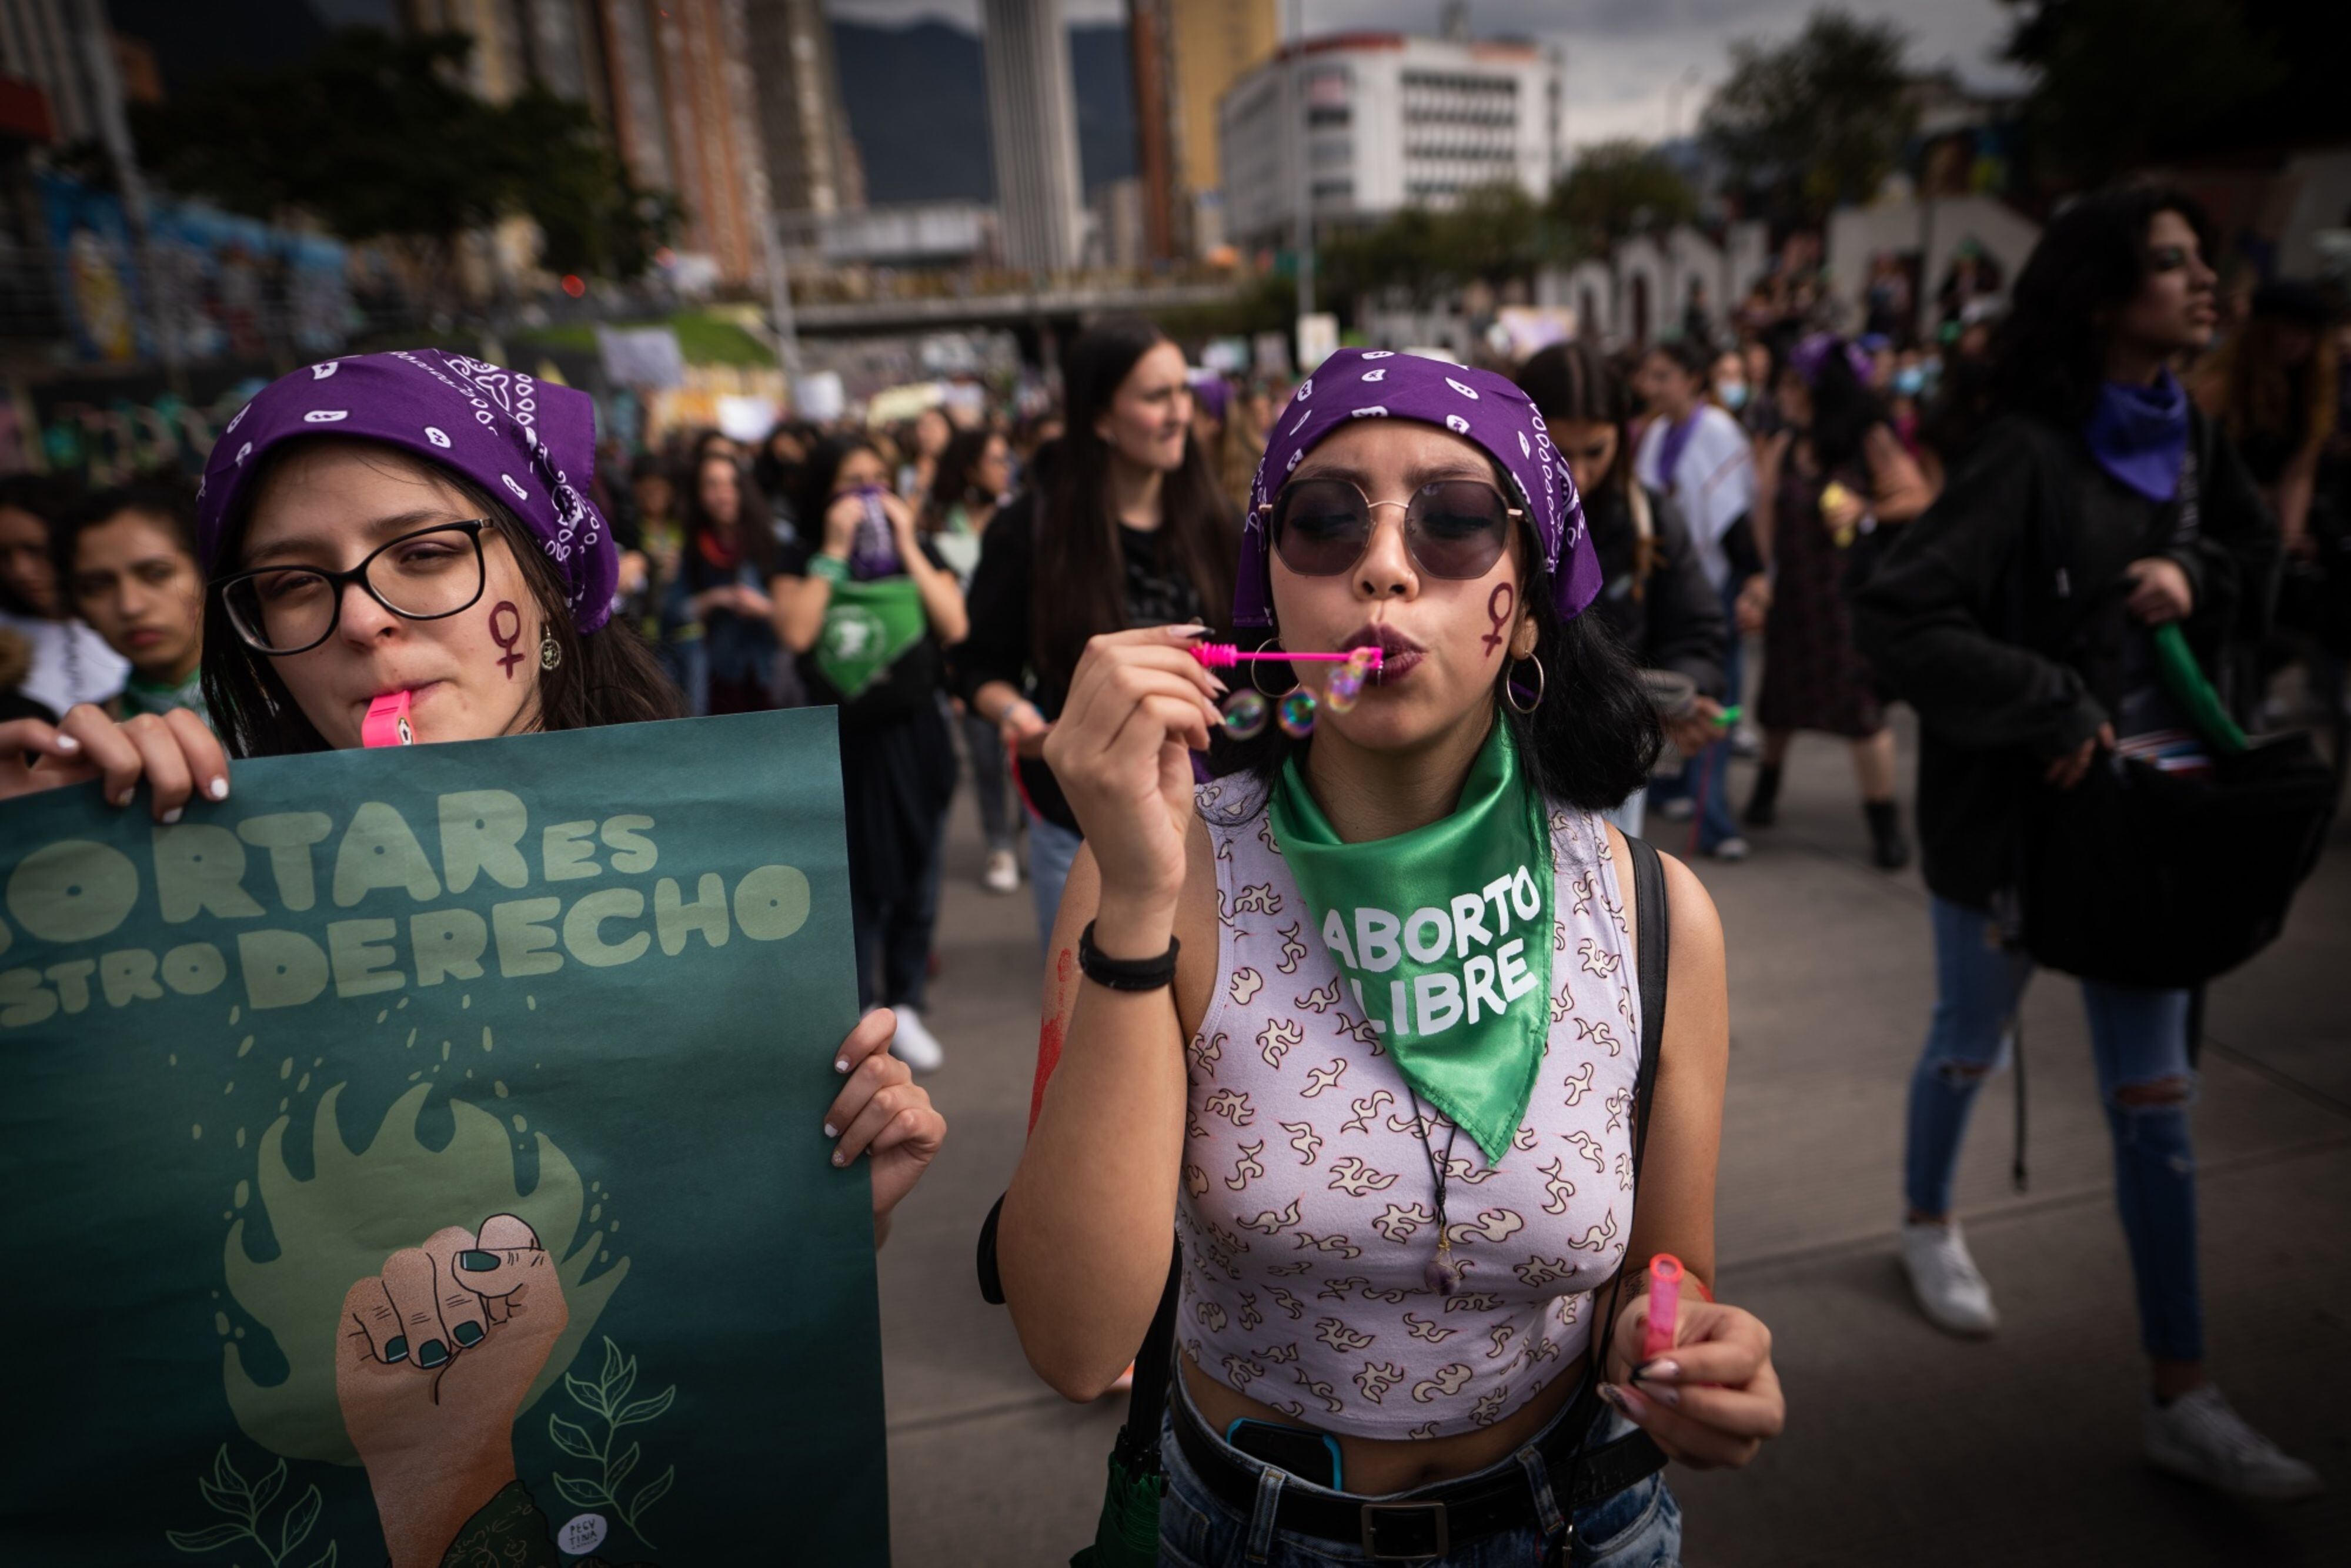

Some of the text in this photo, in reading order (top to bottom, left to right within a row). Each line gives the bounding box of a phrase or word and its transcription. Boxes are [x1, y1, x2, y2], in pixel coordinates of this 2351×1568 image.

[0, 790, 659, 956] ORTAR ES
[1323, 865, 1541, 972] ABORTO
[236, 864, 812, 1009] DERECHO
[1350, 938, 1538, 1036] LIBRE
